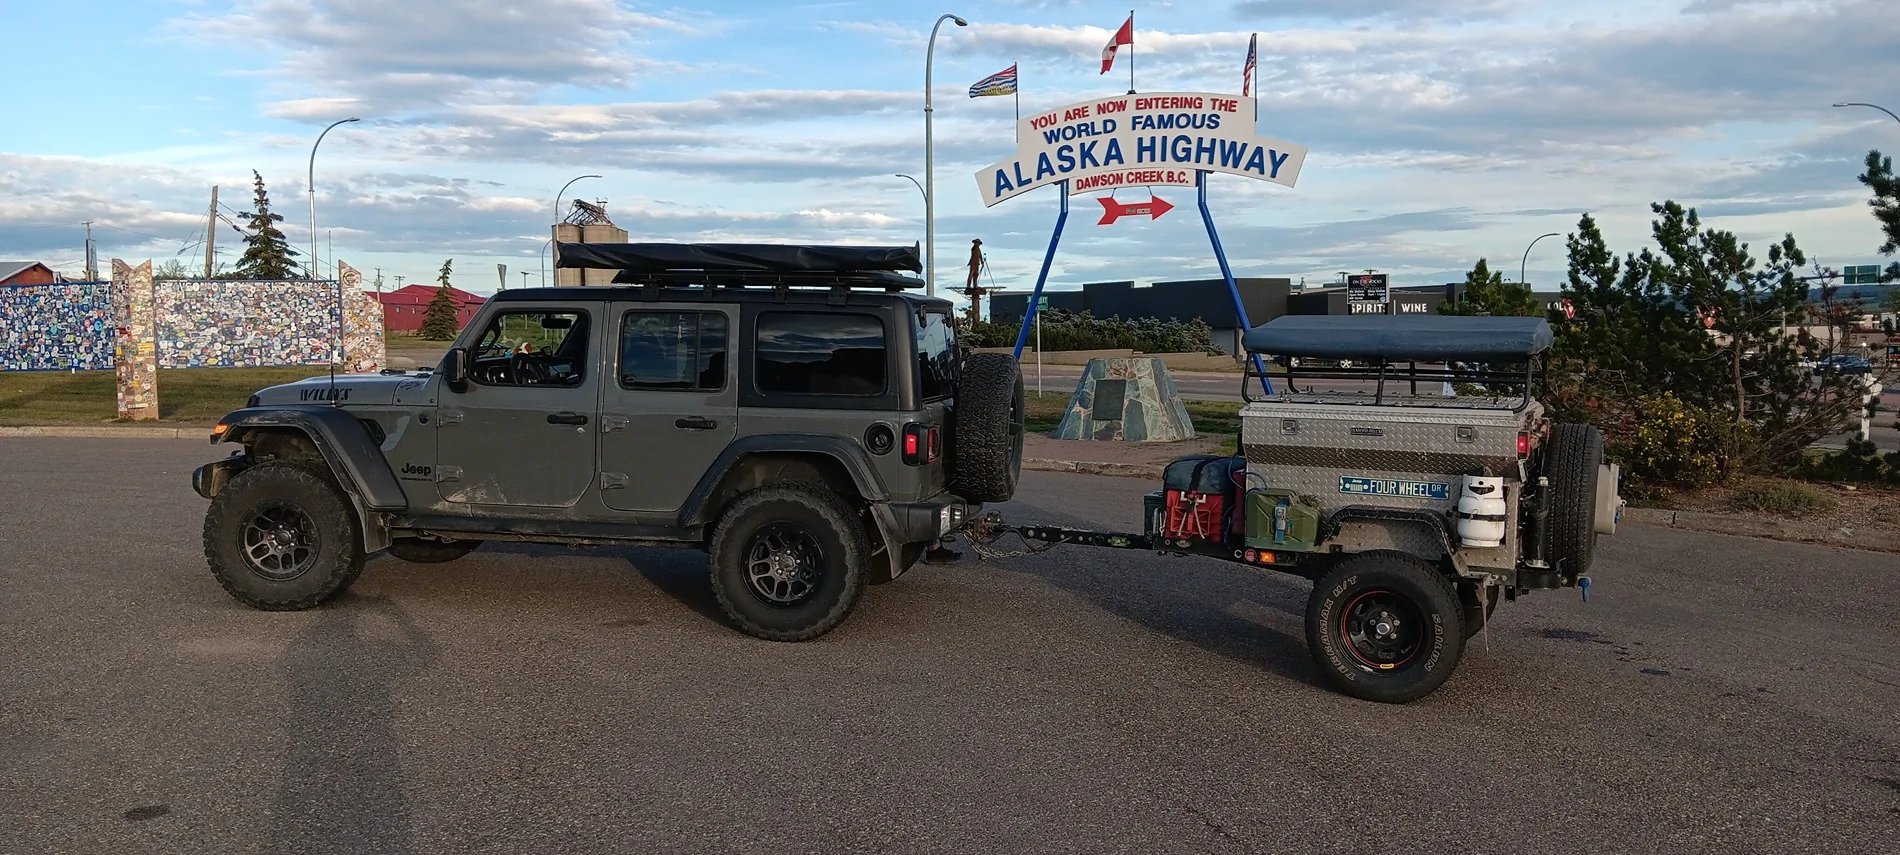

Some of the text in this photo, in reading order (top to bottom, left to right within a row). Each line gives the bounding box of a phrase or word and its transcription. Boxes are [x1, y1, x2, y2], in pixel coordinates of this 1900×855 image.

[1030, 97, 1238, 130] YOU ARE NOW ENTERING THE
[1043, 113, 1221, 144] WORLD FAMOUS
[995, 134, 1289, 197] ALASKA HIGHWAY
[1076, 171, 1189, 190] DAWSON CREEK B.C.
[1401, 303, 1427, 313] WINE
[401, 463, 431, 477] Jeep
[1369, 480, 1441, 497] FOUR WHEEL DR
[1332, 575, 1357, 598] H/T
[1424, 613, 1444, 672] SAILUN
